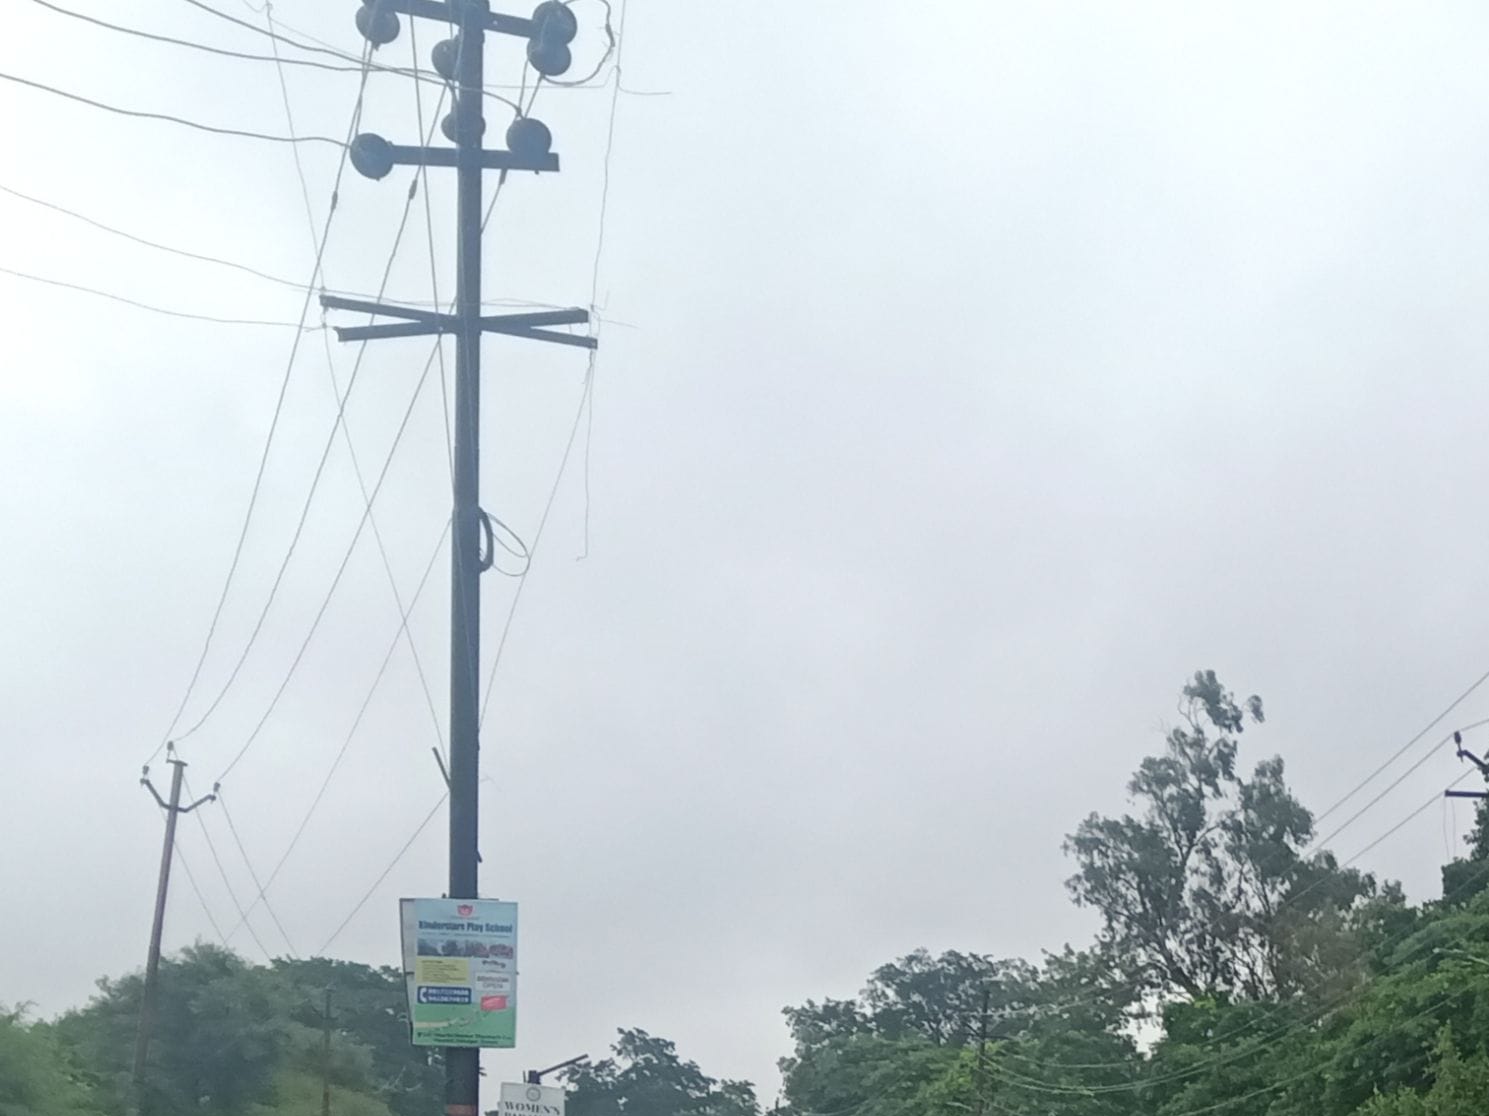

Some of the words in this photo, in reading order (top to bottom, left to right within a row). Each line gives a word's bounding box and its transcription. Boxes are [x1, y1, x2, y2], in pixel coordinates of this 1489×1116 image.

[466, 922, 484, 933] Play
[485, 923, 513, 934] School
[504, 1101, 560, 1116] WOMEN'S
